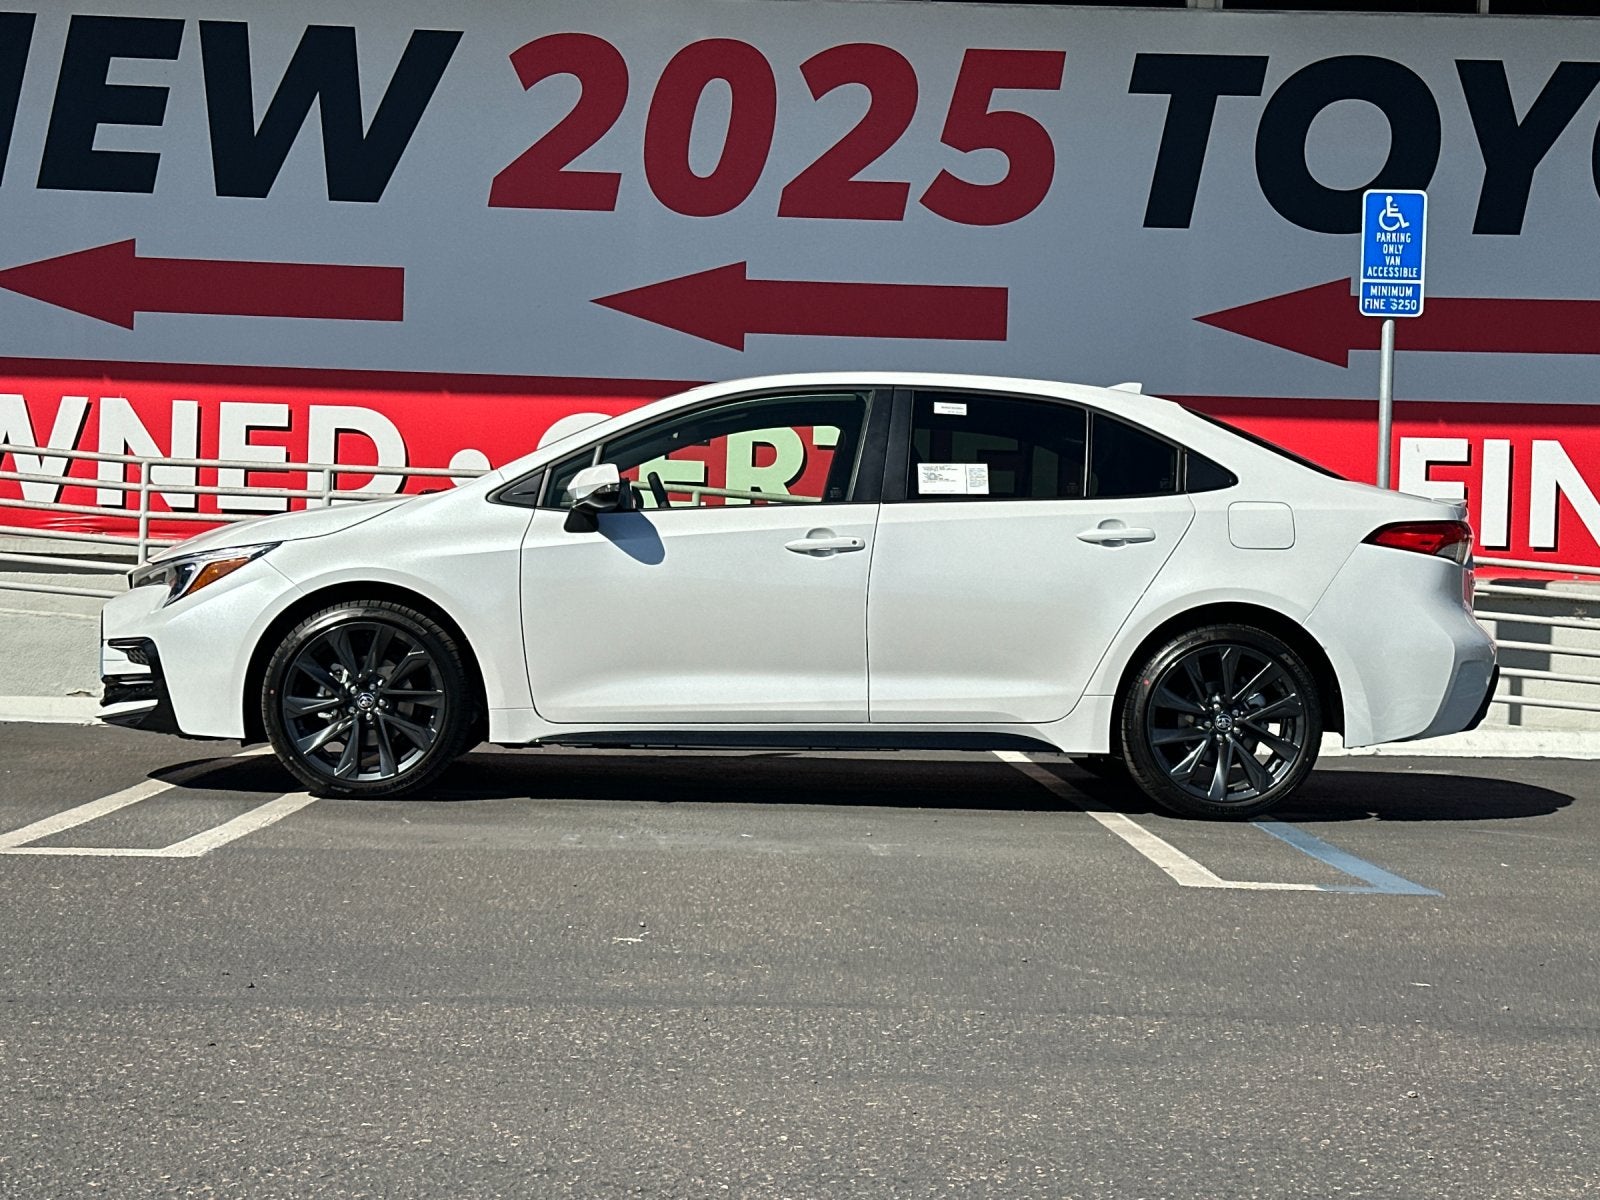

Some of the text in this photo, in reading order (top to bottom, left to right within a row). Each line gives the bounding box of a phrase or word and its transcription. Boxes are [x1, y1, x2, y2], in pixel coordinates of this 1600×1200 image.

[487, 32, 1067, 226] 2025
[1128, 53, 1600, 236] TOY
[1376, 232, 1411, 243] PARKING
[1382, 244, 1404, 254] ONLY
[1385, 256, 1401, 266] VAN
[1366, 266, 1418, 278] ACCESSIBLE
[1370, 285, 1413, 297] MINIMUM
[1364, 298, 1417, 310] FINE $250
